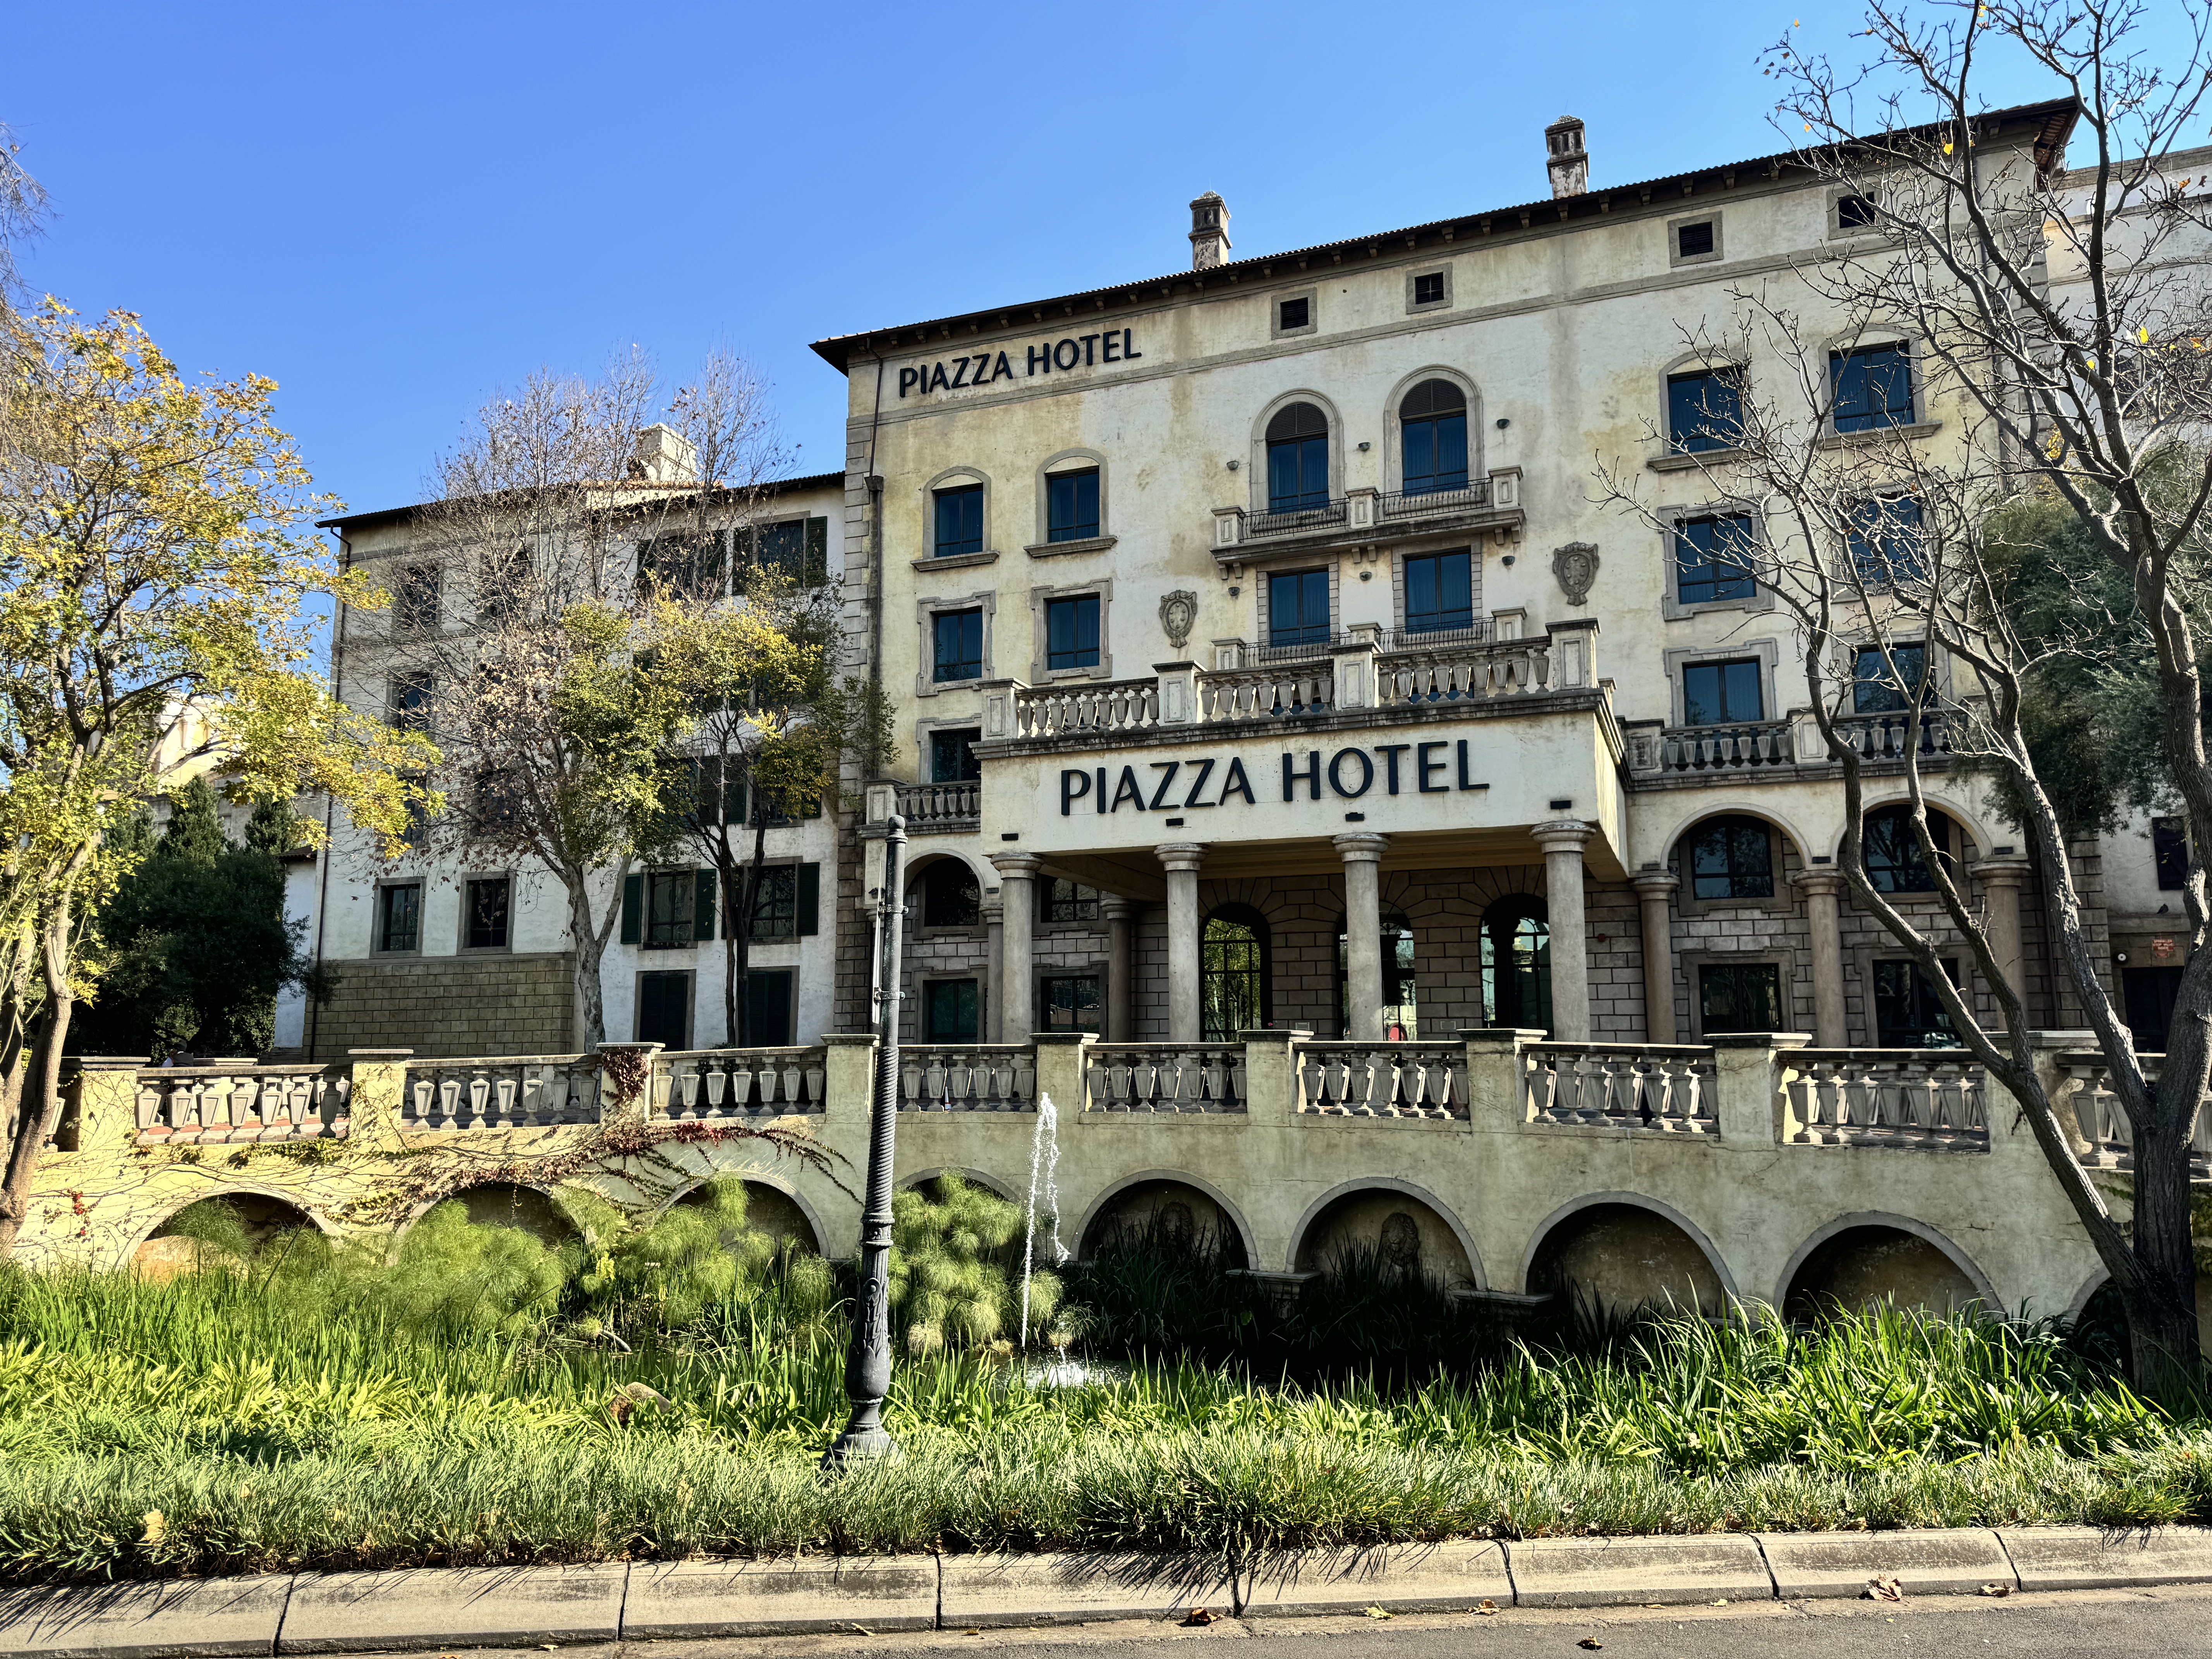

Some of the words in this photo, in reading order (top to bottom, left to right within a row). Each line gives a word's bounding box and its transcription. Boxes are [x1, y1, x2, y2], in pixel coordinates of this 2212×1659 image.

[899, 350, 1013, 398] PIAZZA
[1028, 328, 1142, 376] HOTEL
[1061, 757, 1255, 816] PIAZZA
[1282, 739, 1490, 802] HOTEL
